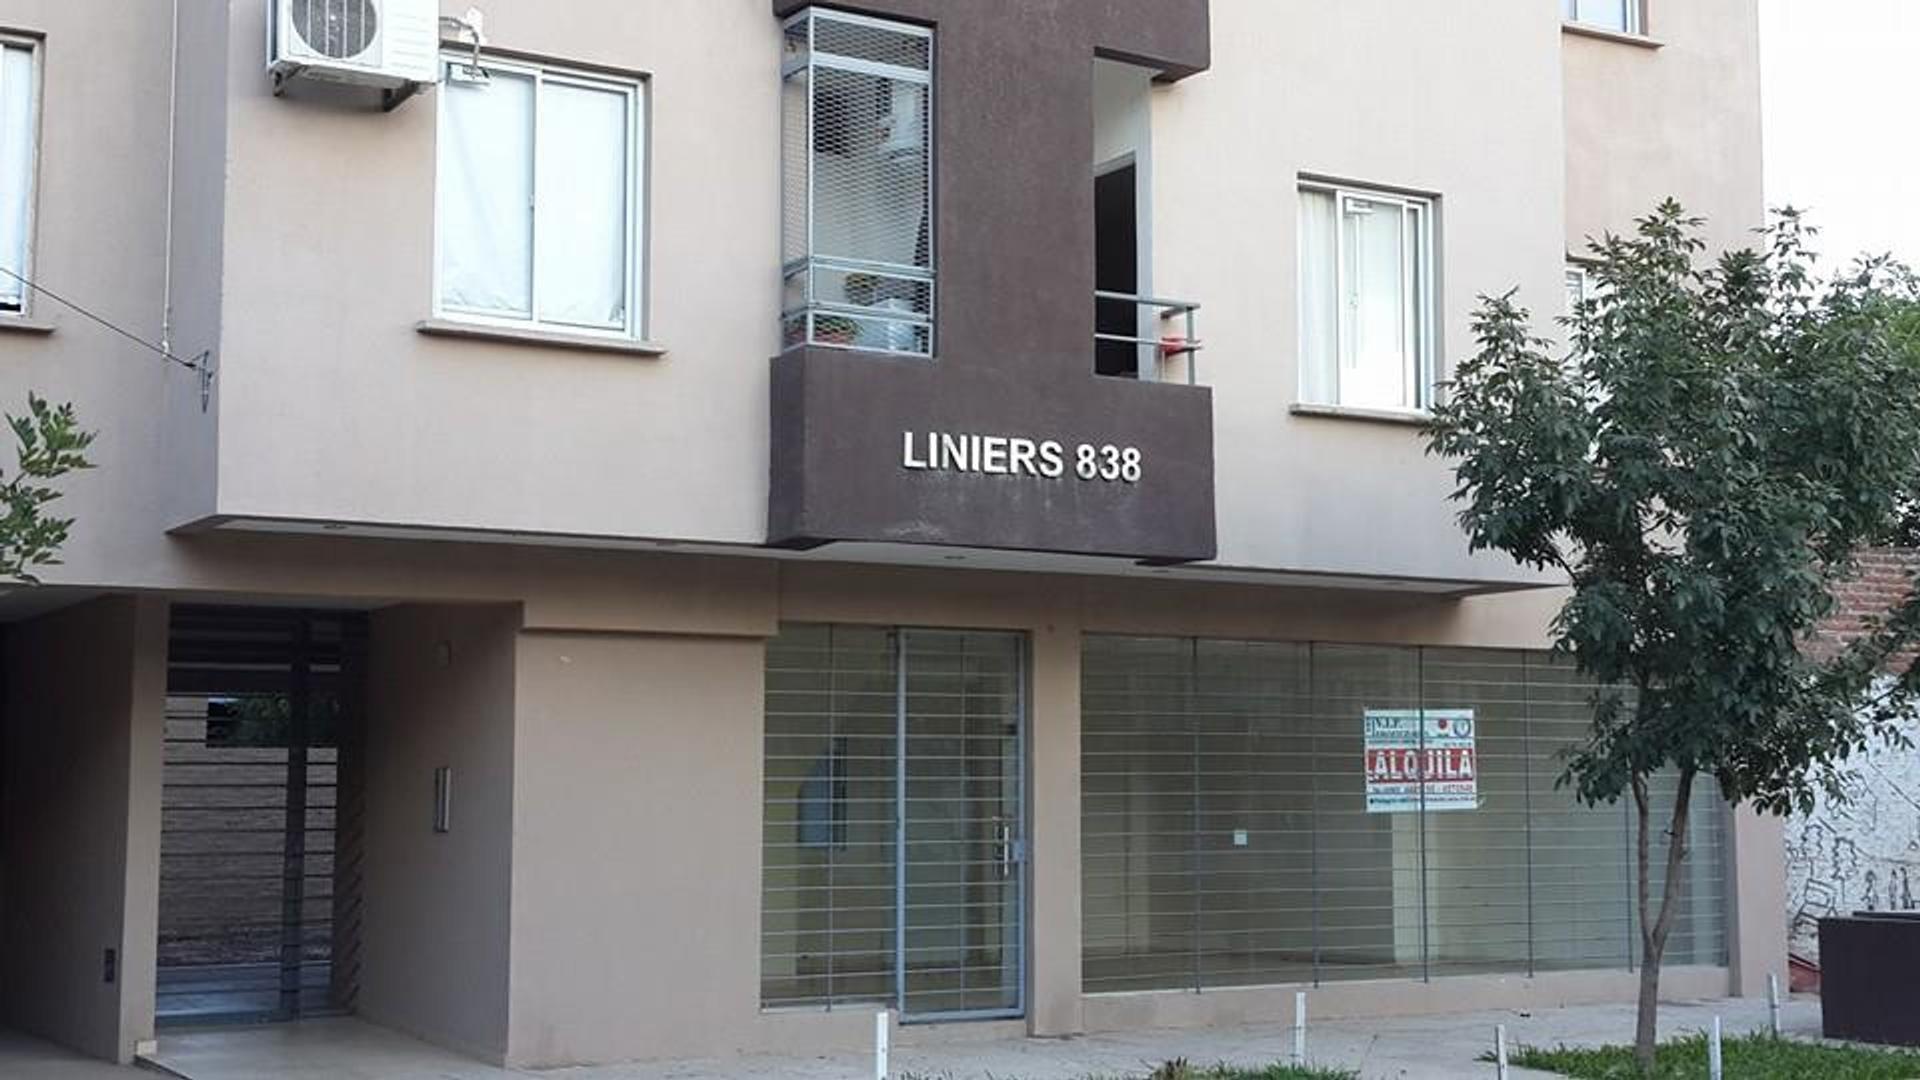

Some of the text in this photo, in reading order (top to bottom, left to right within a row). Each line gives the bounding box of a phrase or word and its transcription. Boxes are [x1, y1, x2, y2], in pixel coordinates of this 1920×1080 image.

[903, 431, 1142, 482] LINIERS 838
[1375, 749, 1473, 779] ALQUILA
